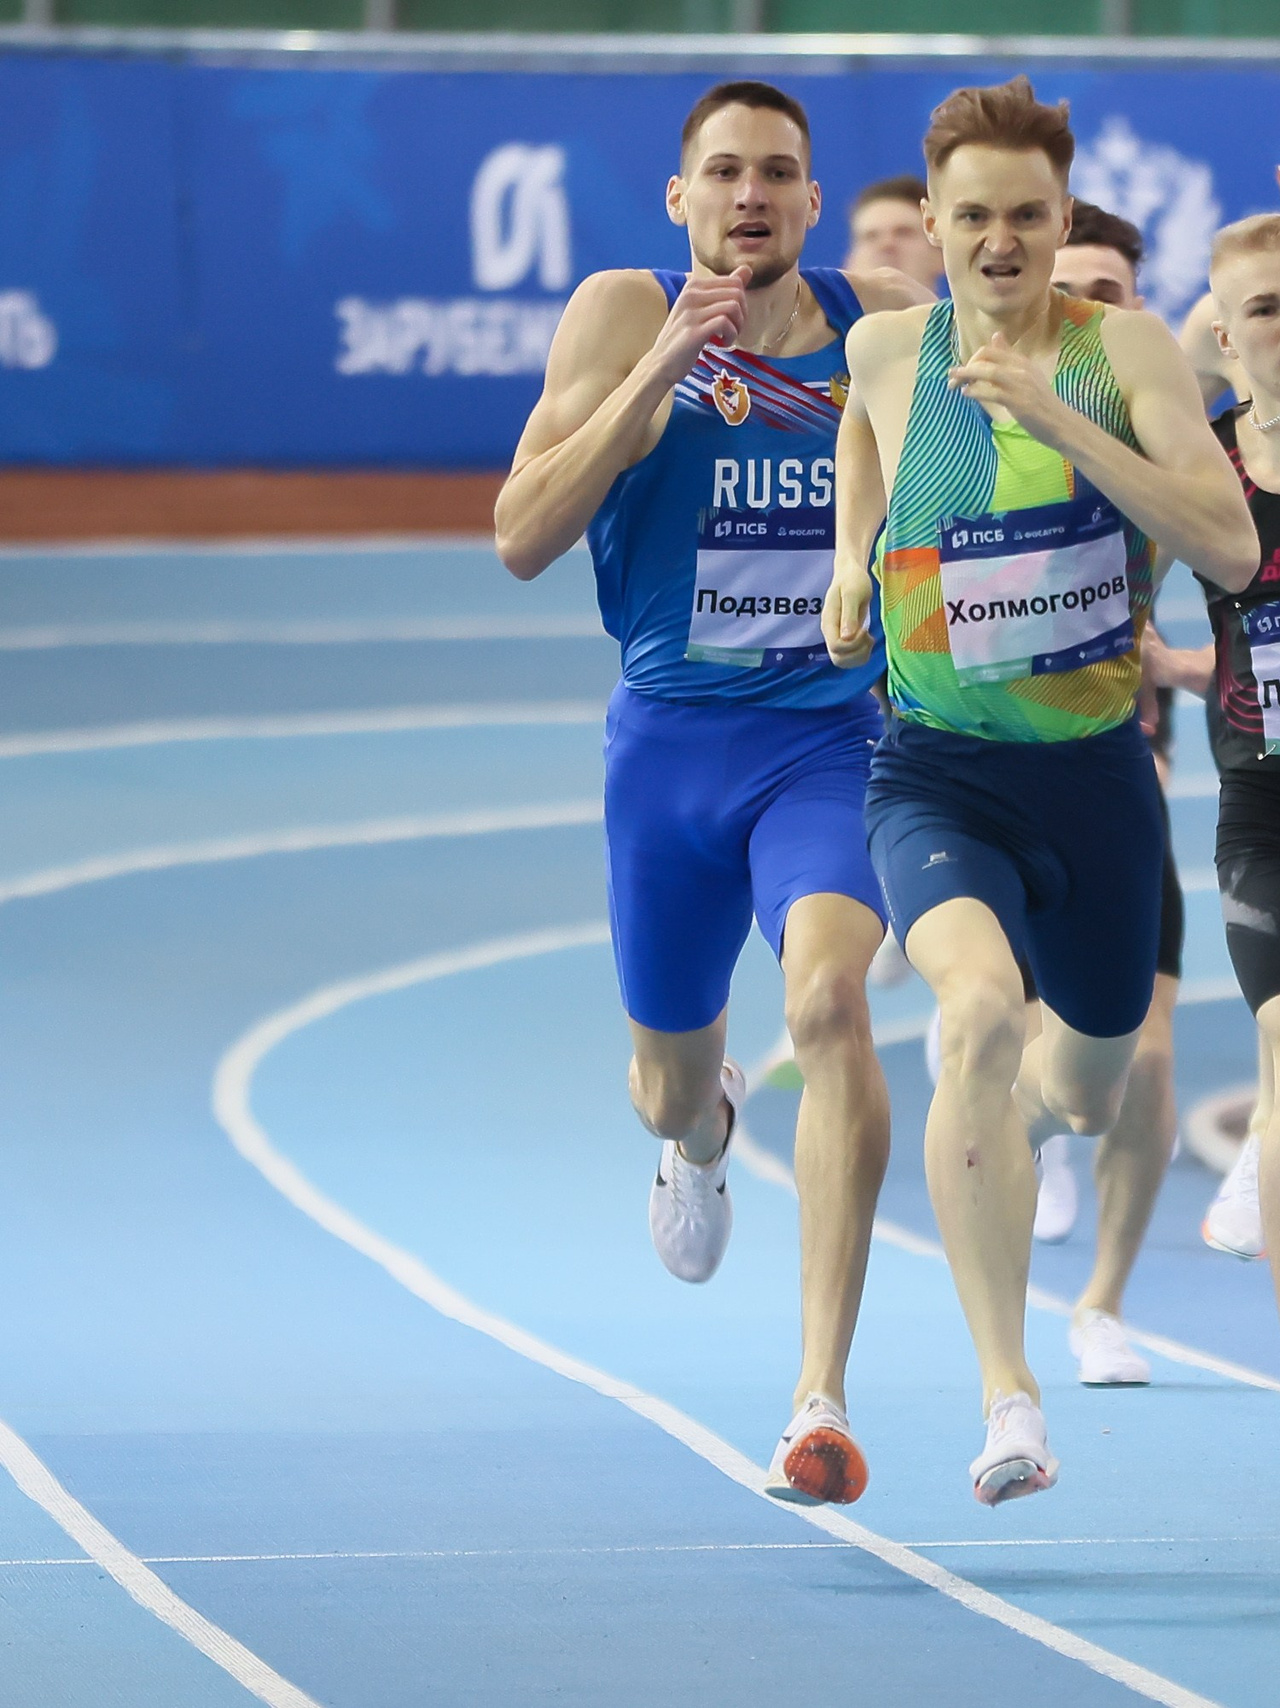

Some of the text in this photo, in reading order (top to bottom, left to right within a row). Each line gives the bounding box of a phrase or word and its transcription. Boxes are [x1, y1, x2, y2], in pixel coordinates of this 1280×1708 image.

[735, 522, 768, 535] ПСБ
[788, 528, 826, 536] ФОСАГРО
[972, 529, 1005, 544] ПСБ
[946, 575, 1126, 626] Холмогоров
